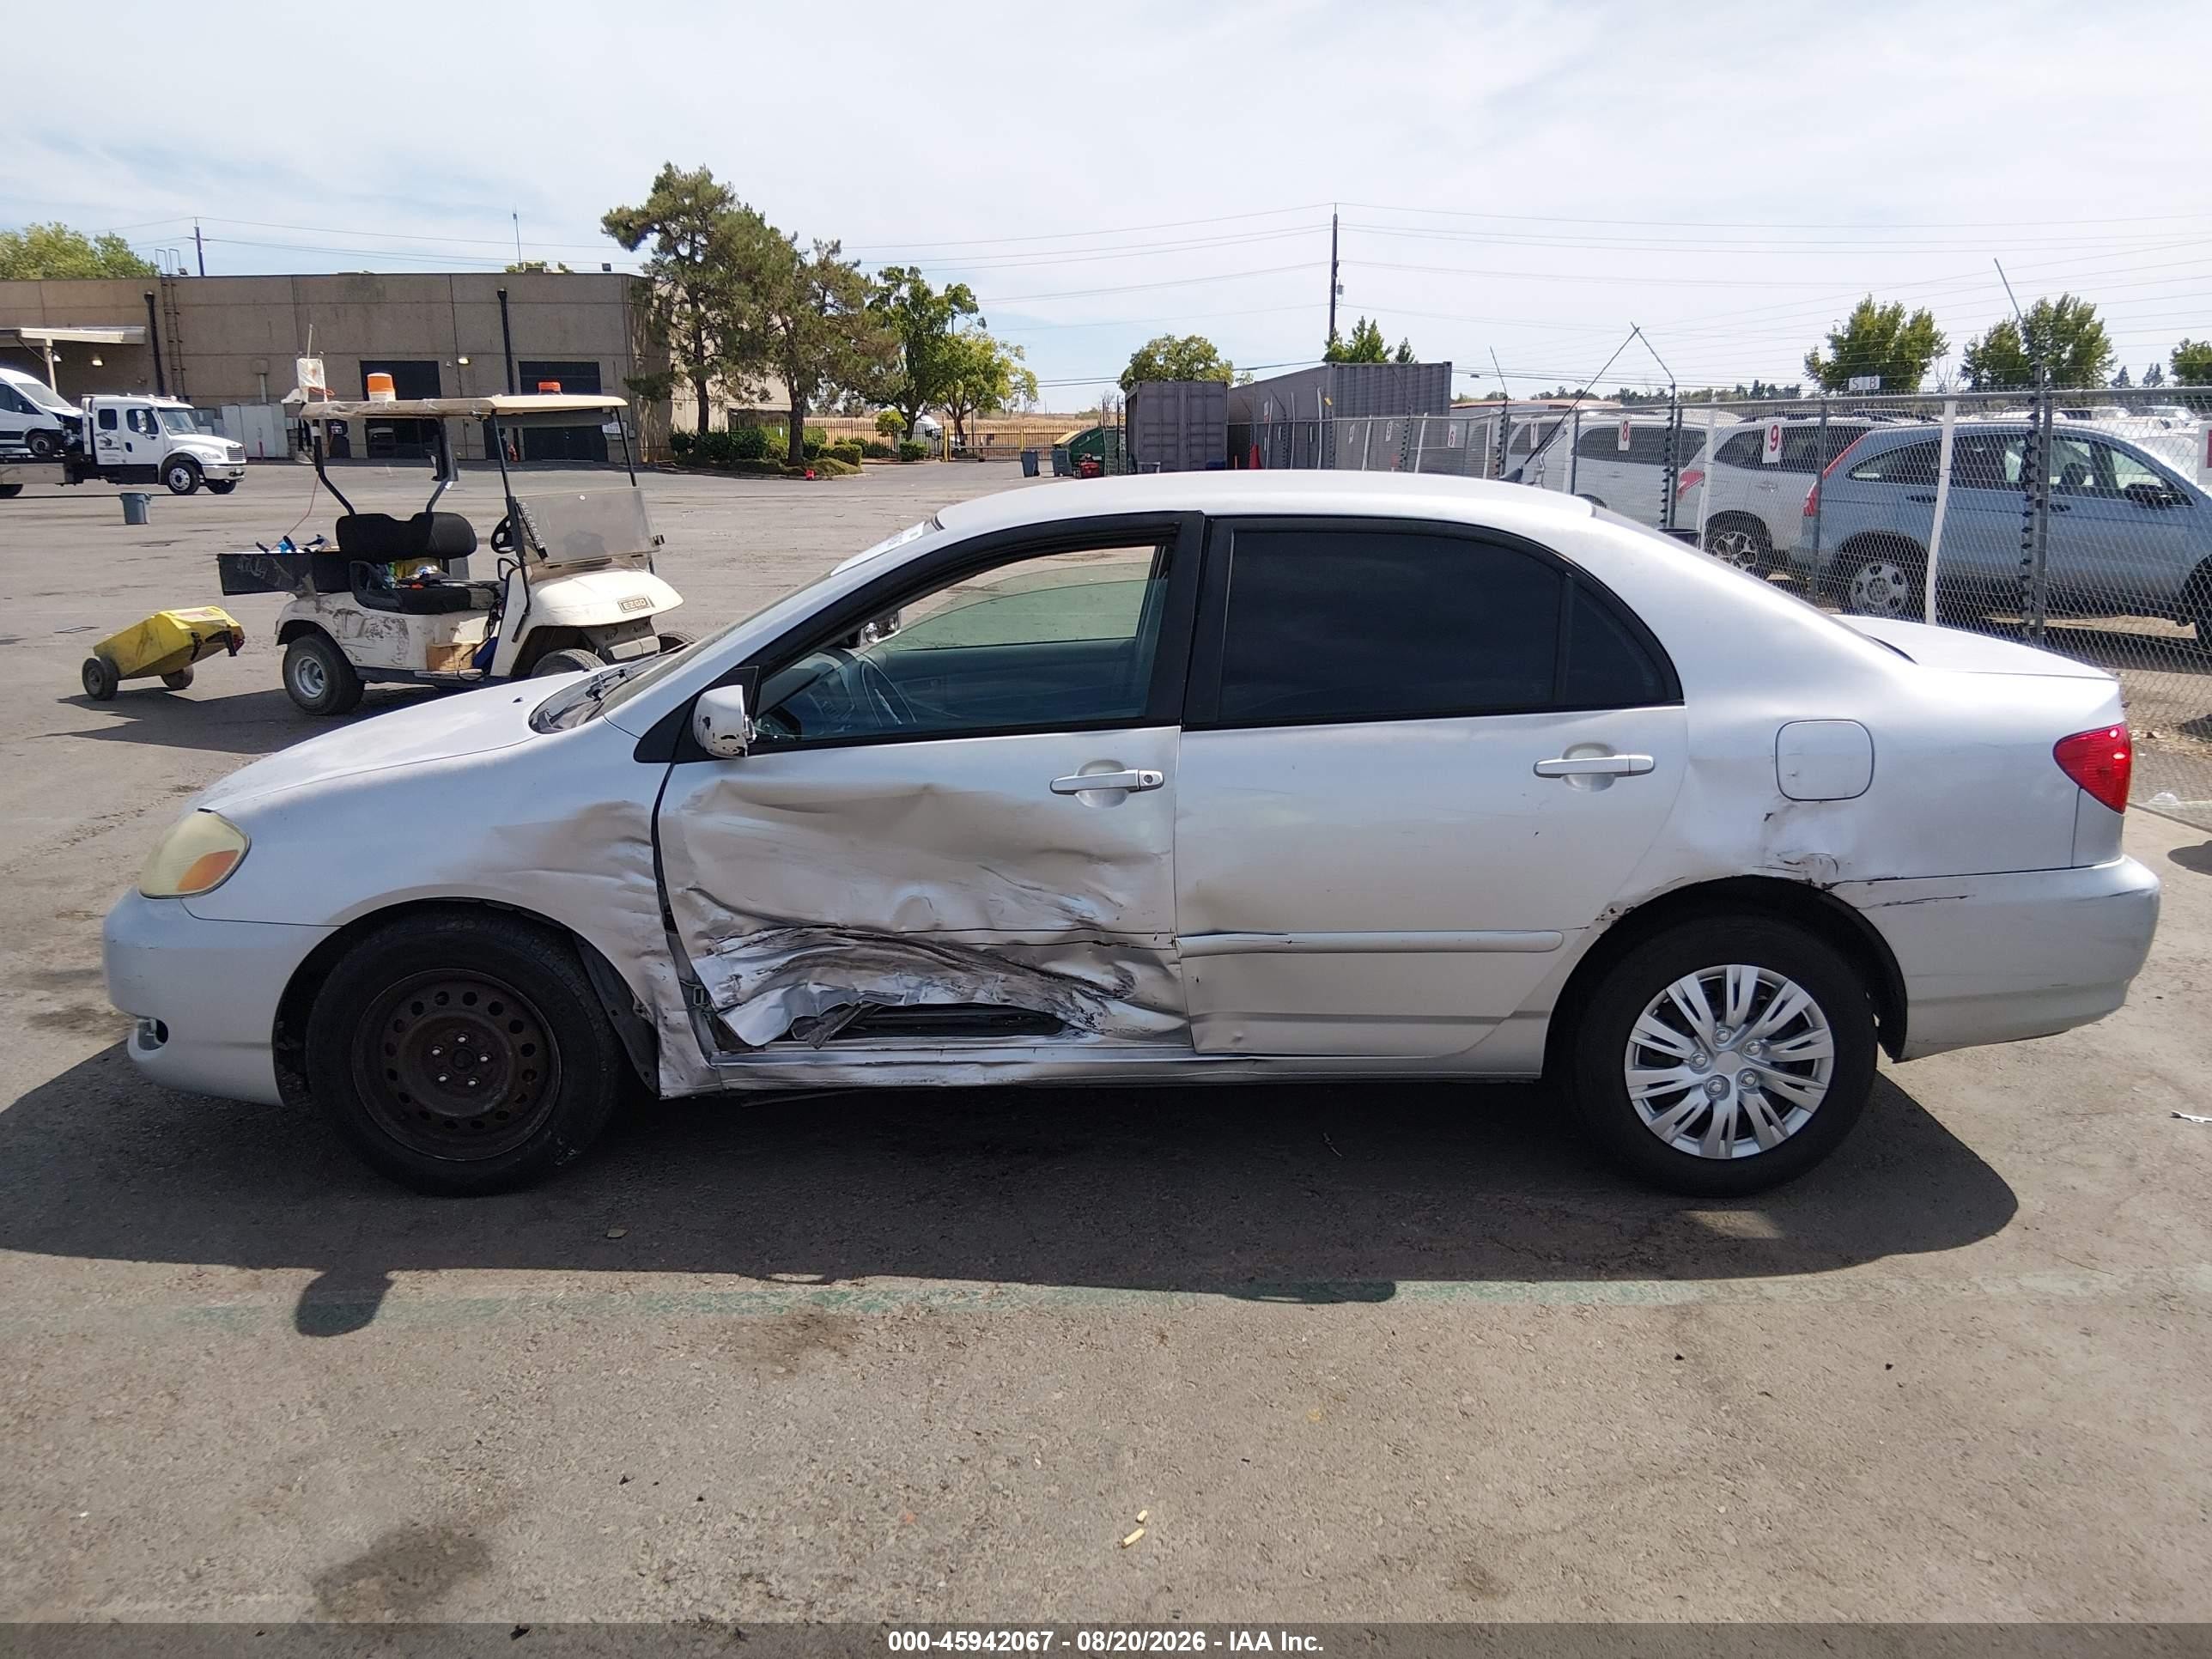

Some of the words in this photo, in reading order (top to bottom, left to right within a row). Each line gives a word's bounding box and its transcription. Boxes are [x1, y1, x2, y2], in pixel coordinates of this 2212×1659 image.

[1852, 378, 1859, 390] S
[1869, 377, 1876, 389] B
[1621, 419, 1630, 442] 8
[1770, 424, 1779, 452] 9
